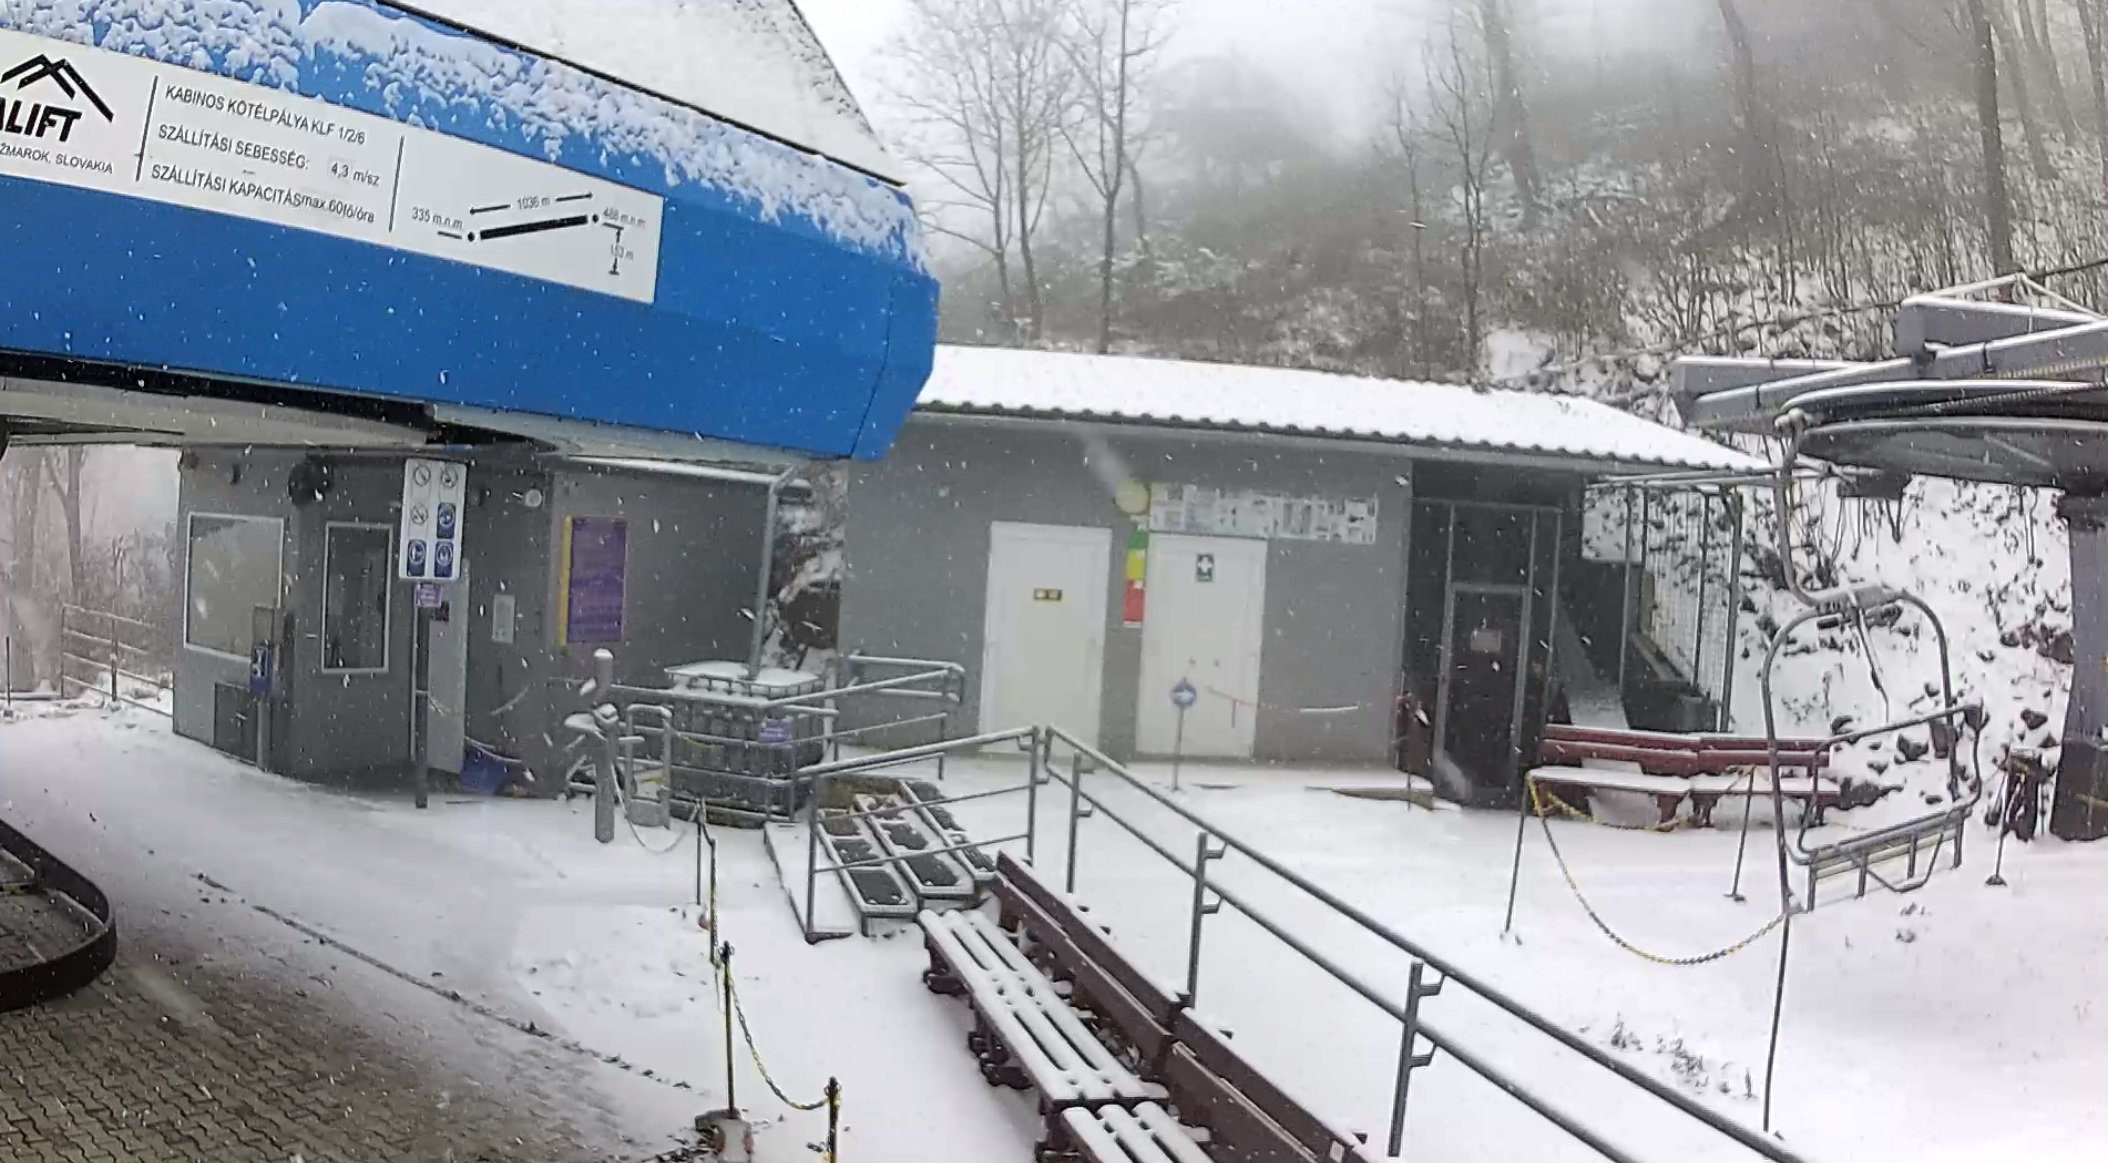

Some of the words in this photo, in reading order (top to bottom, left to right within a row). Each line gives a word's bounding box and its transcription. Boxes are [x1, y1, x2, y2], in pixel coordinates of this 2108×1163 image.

[0, 96, 82, 142] LIFT
[165, 84, 226, 111] KABINOS
[311, 119, 336, 137] KLF
[338, 126, 366, 145] 1/2/6
[55, 153, 113, 175] SLOVAKIA
[158, 124, 232, 154] SZÁLLÍTÁSI
[235, 140, 310, 170] SEBESSÉG:
[331, 162, 349, 179] 4,3
[352, 169, 380, 187] m/sz
[151, 164, 227, 193] SZÁLLÍTÁSI
[412, 206, 431, 223] 335
